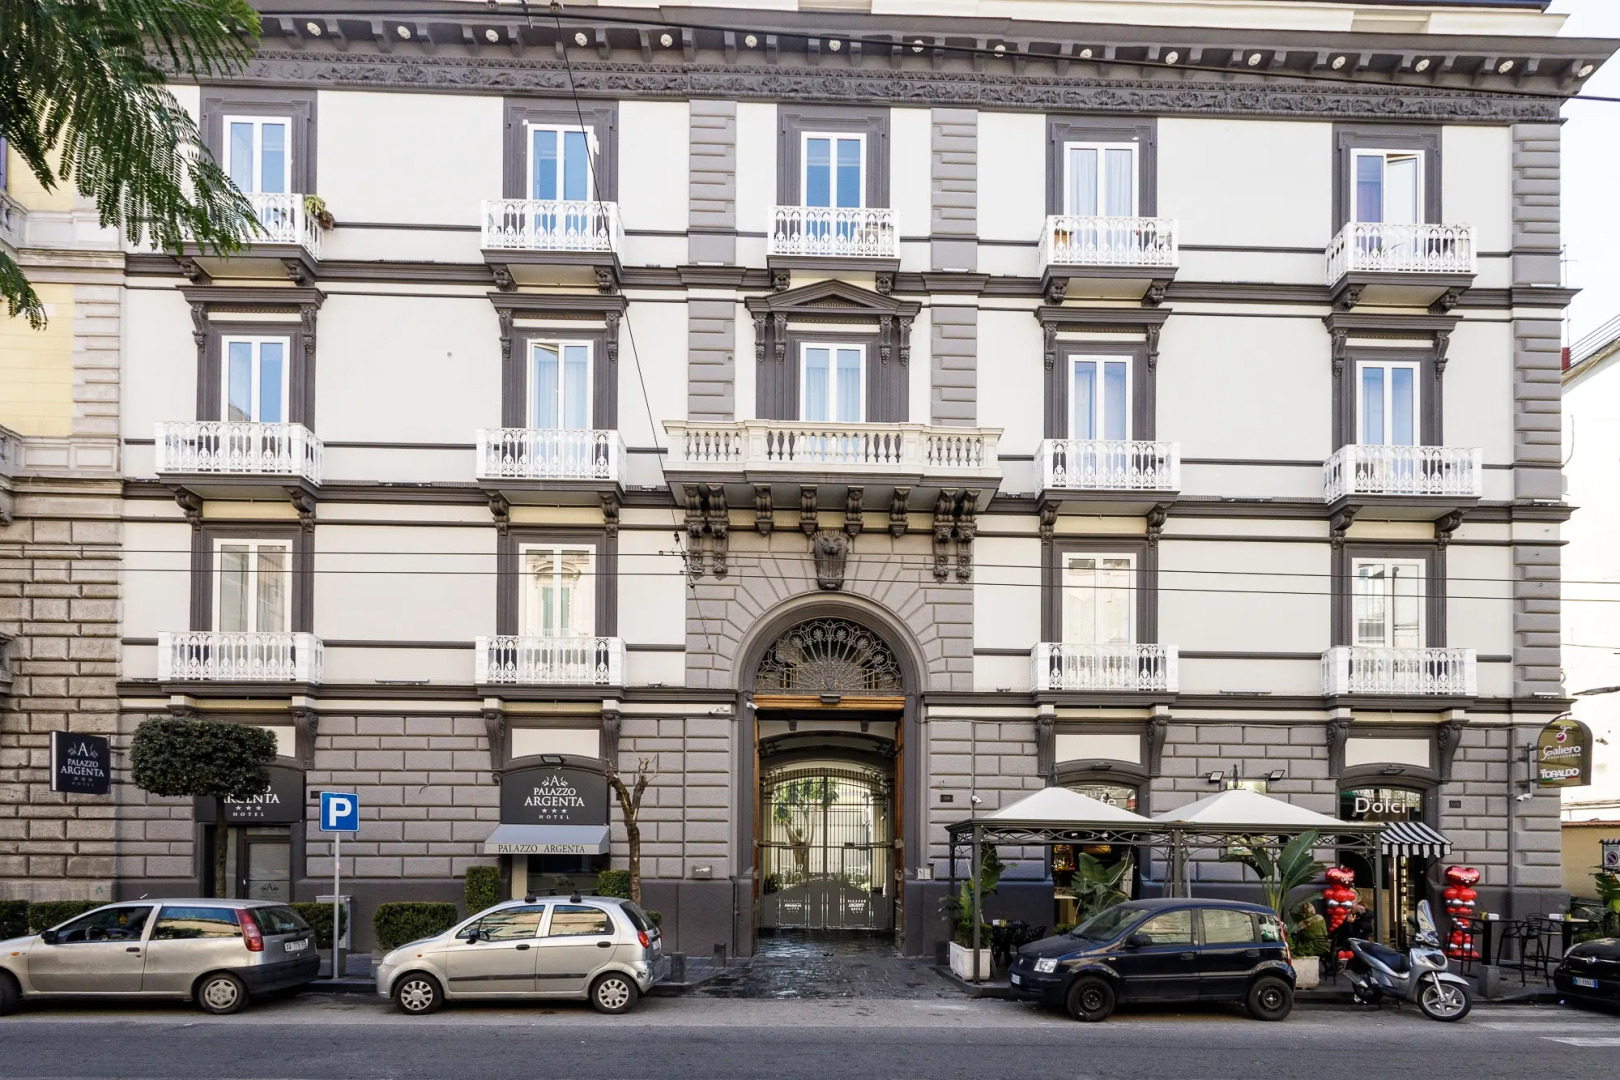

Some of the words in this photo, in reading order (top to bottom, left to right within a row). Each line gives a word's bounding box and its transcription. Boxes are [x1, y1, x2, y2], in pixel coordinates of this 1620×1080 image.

[77, 743, 89, 756] A
[67, 758, 98, 767] PALAZZO
[61, 766, 104, 777] ARGENTA
[550, 775, 560, 787] A
[524, 797, 585, 806] ARGENTA
[1355, 798, 1406, 813] Dolci
[328, 797, 352, 827] P
[498, 844, 538, 853] PALAZZO
[543, 844, 585, 853] ARGENTA
